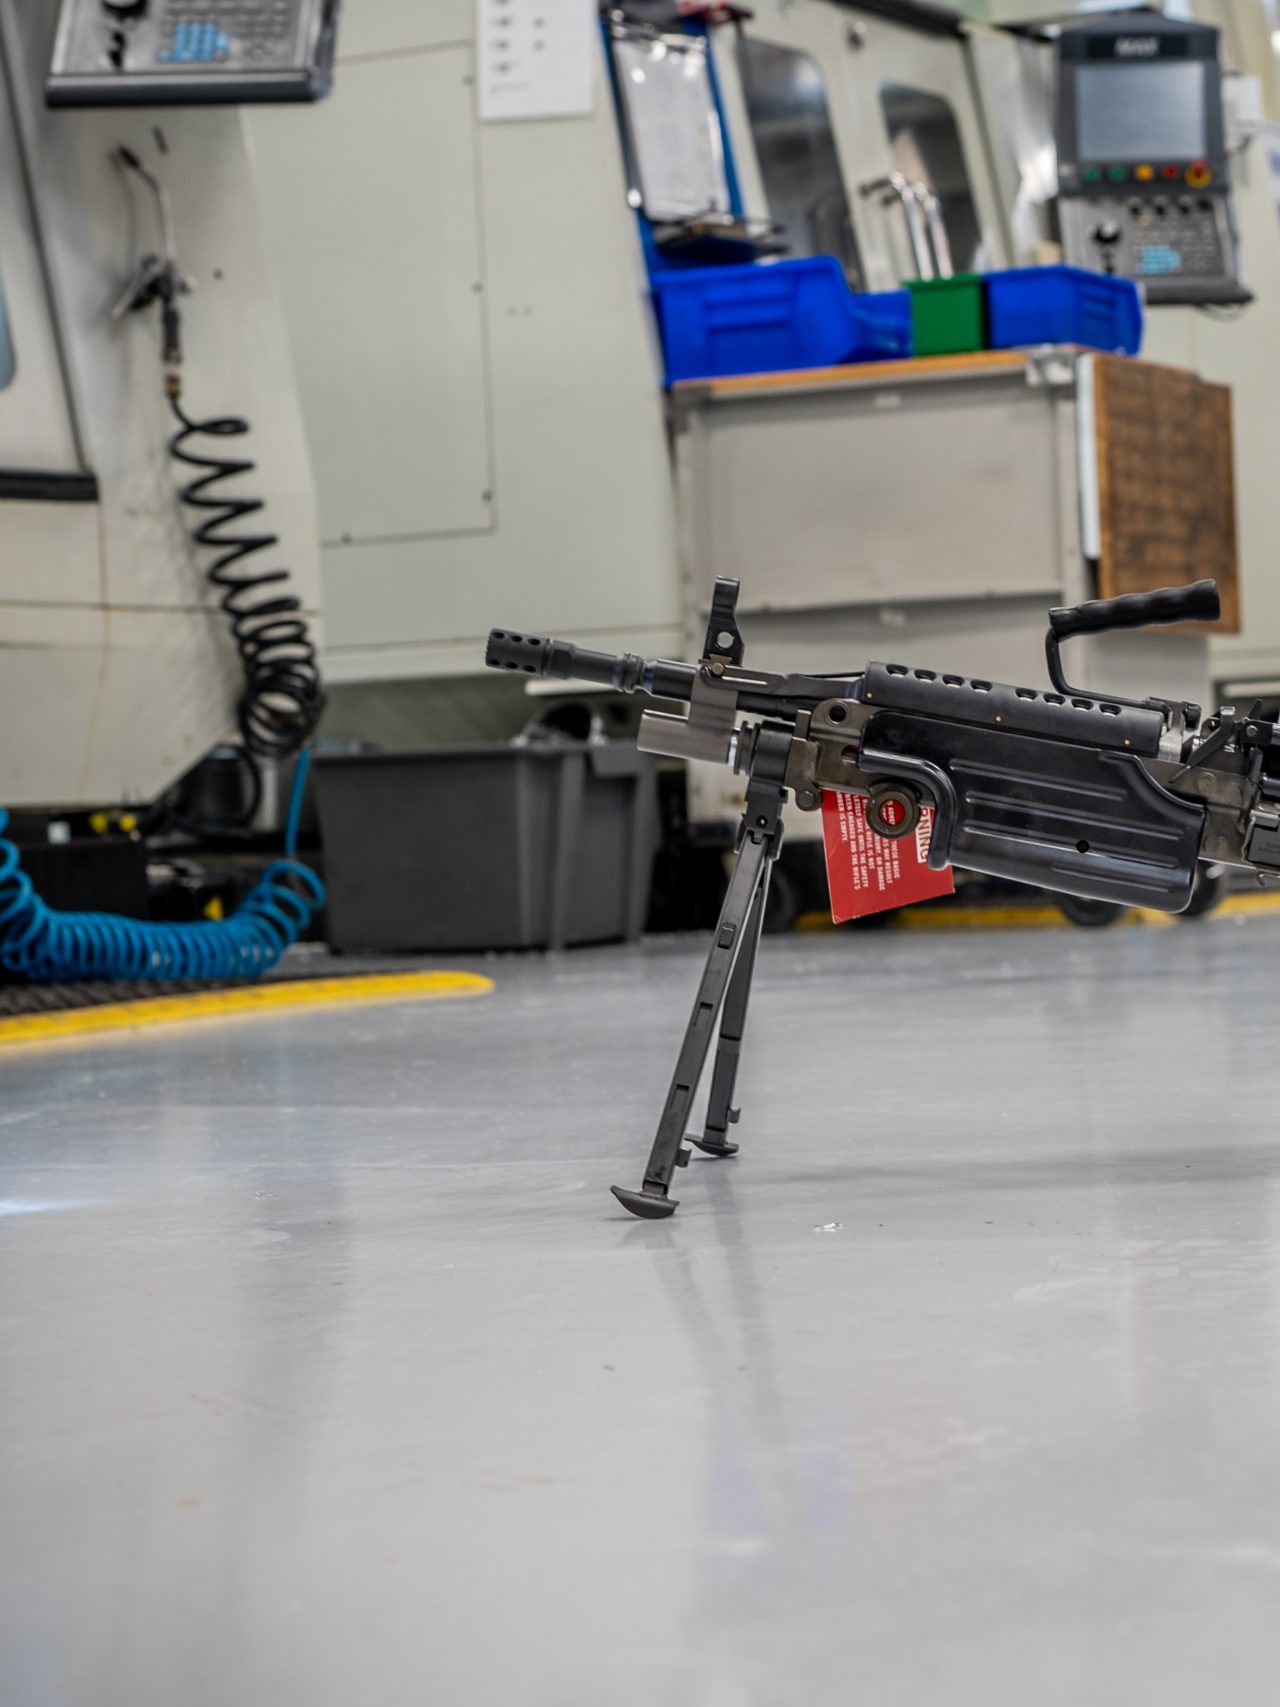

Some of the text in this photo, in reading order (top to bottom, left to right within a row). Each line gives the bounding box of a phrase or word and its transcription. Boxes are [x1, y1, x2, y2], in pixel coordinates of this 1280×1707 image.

[838, 812, 845, 820] IS
[839, 821, 847, 843] EMPTY.
[846, 811, 855, 839] ENGAGED
[852, 866, 860, 890] RIFLE'S
[857, 834, 865, 851] UNTIL
[890, 840, 898, 858] THESE
[875, 856, 882, 865] OR
[892, 860, 900, 878] BASIC
[860, 865, 868, 887] SAFETY
[876, 866, 884, 890] DAMAGE
[884, 861, 892, 883] RESULT
